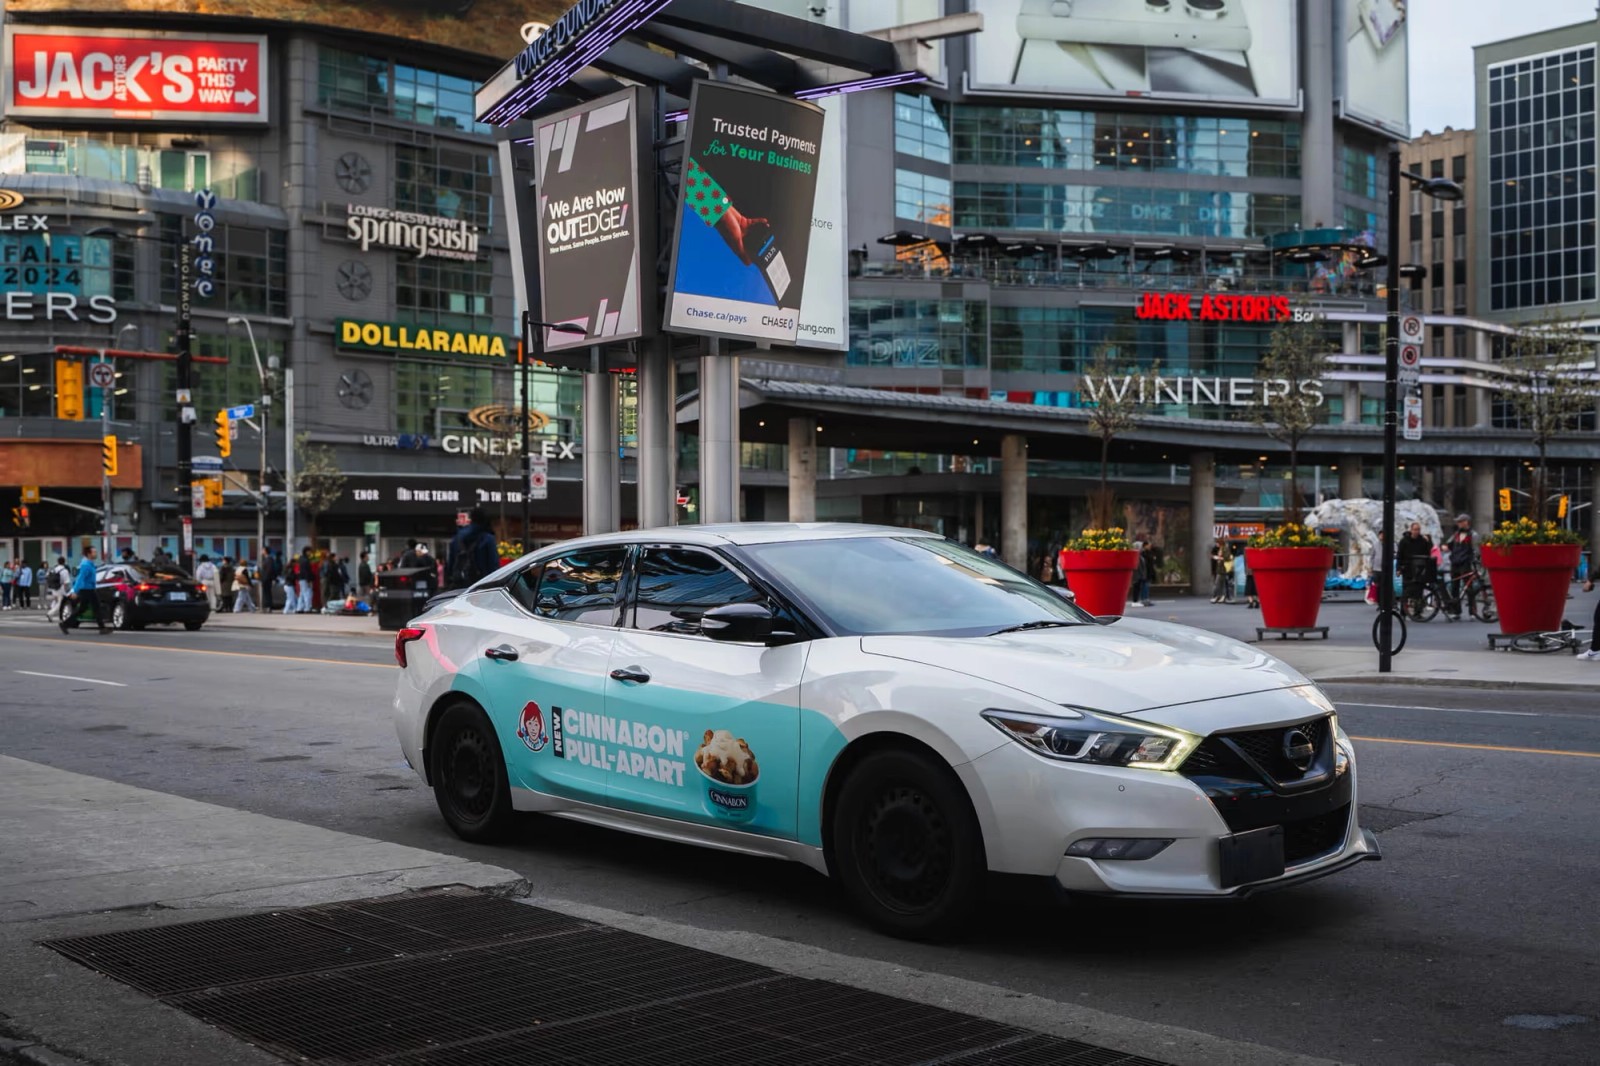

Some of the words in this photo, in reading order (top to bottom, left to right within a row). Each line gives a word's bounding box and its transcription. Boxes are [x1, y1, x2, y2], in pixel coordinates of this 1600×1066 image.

[196, 56, 248, 73] PARTY
[18, 50, 195, 104] JACK'S
[198, 73, 236, 87] THIS
[198, 89, 234, 104] WAY
[712, 117, 768, 142] Trusted
[771, 129, 816, 156] Payments
[703, 139, 728, 156] for
[729, 143, 764, 162] Your
[767, 151, 812, 175] Business
[548, 200, 569, 220] We
[571, 195, 594, 214] Are
[595, 187, 626, 208] Now
[4, 244, 82, 264] FALL
[4, 267, 82, 286] 2024
[686, 307, 748, 324] Chase.ca/pays
[761, 315, 788, 329] CHASE
[1136, 292, 1193, 320] JACK
[1200, 293, 1291, 322] ASTOR'S
[342, 320, 507, 358] DOLLARAMA
[871, 338, 940, 364] DMZ
[1083, 375, 1325, 408] WINNERS
[363, 434, 398, 447] ULTRA
[352, 488, 380, 501] ENOR
[413, 489, 430, 502] THE
[553, 711, 563, 753] NEW
[565, 737, 686, 788] PULL-APART
[710, 790, 747, 807] CINNABON
